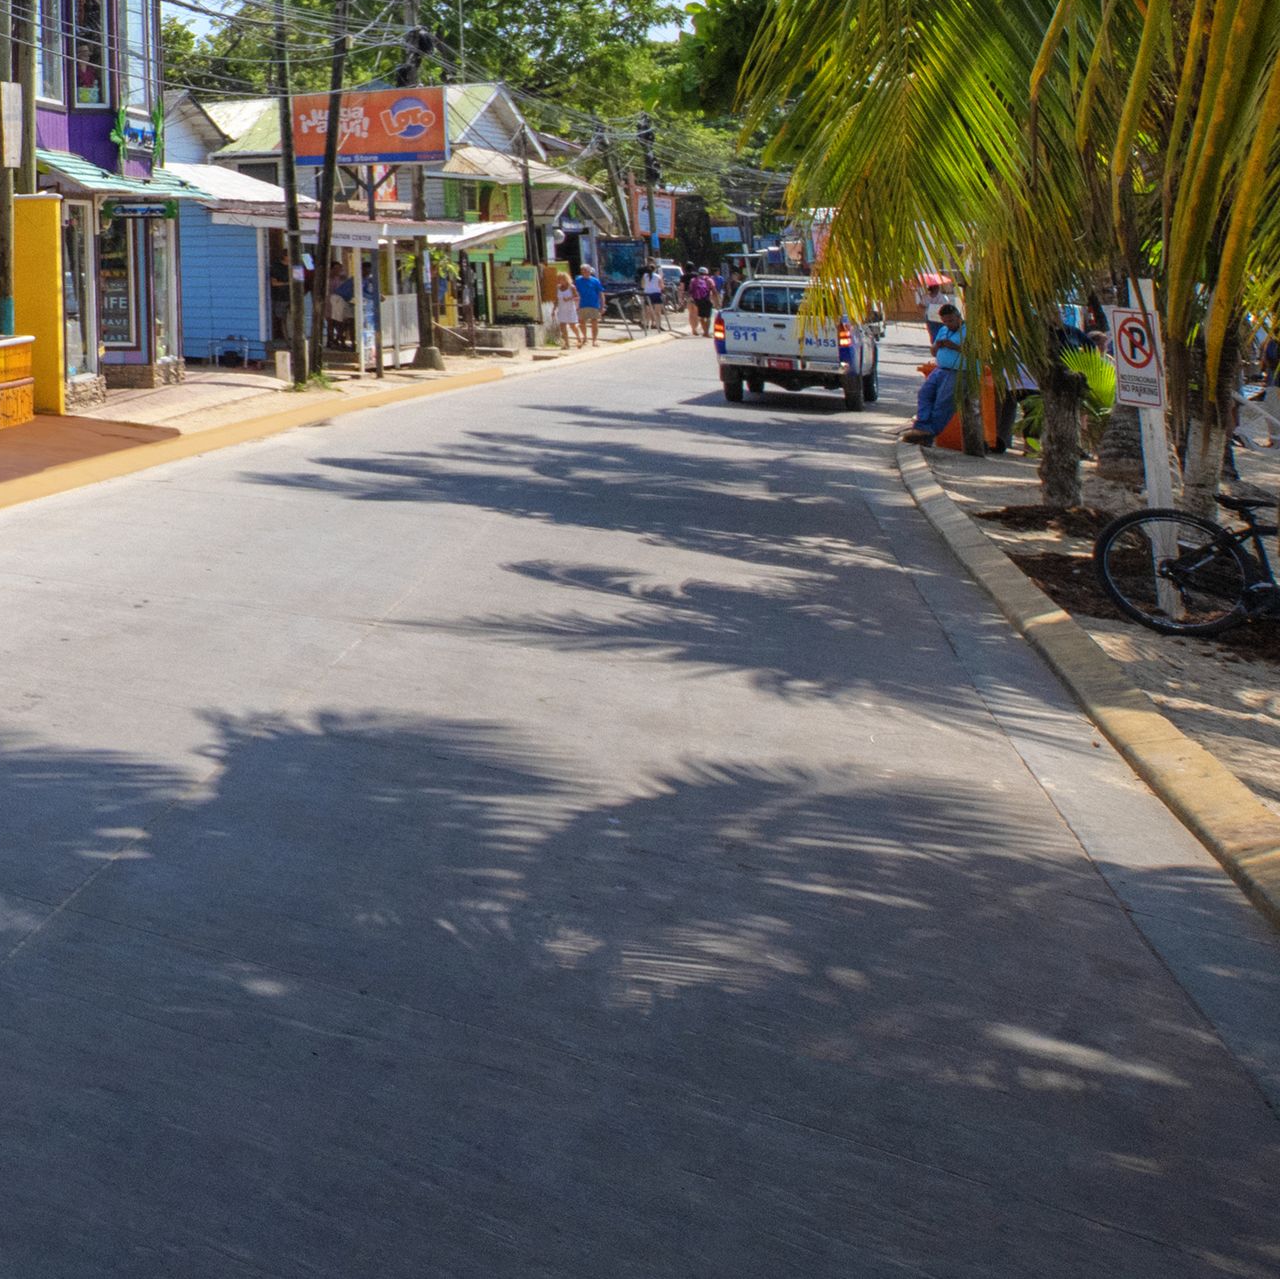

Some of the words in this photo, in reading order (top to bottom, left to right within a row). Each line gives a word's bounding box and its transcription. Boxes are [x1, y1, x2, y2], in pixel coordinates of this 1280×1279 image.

[355, 154, 378, 162] Store
[733, 331, 757, 341] 911
[799, 337, 837, 348] N-153
[1121, 384, 1131, 392] NO
[1131, 384, 1158, 396] PARKING
